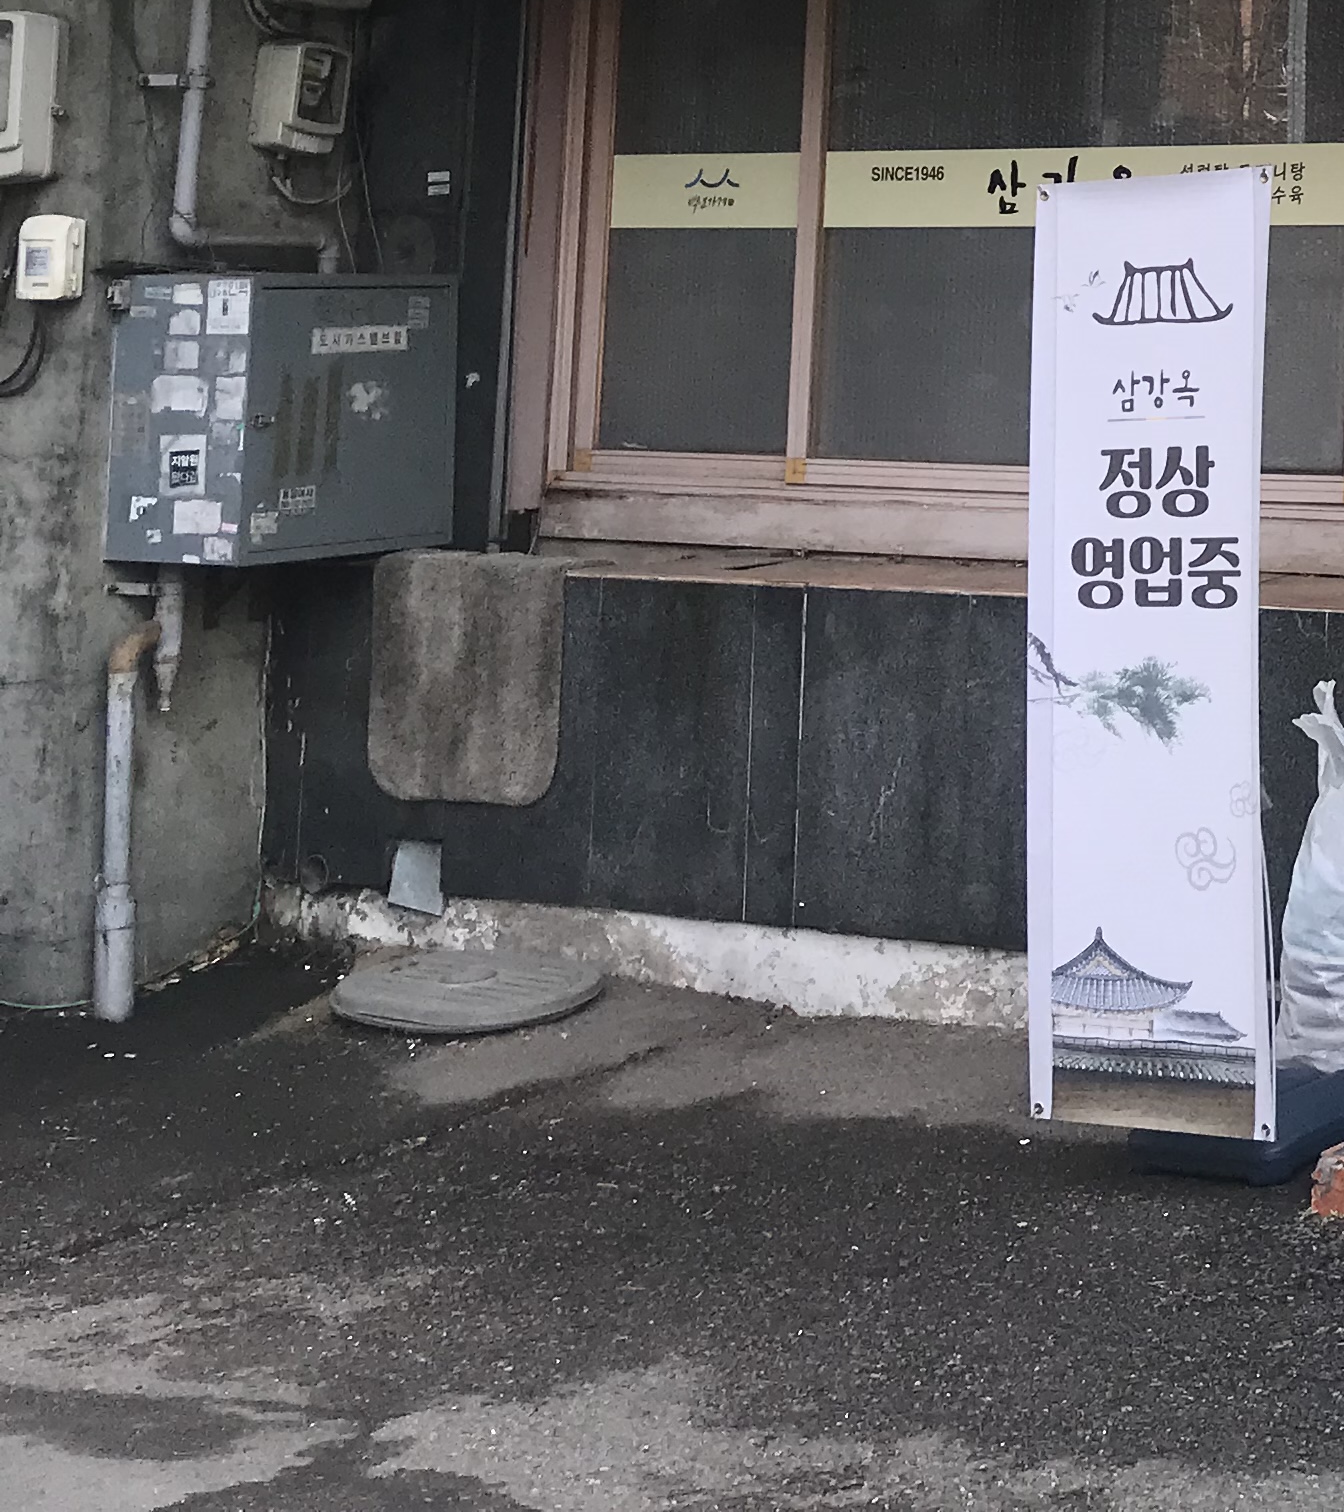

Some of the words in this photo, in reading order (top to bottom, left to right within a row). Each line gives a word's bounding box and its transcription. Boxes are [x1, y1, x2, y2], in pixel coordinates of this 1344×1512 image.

[871, 166, 945, 182] SINCE1946
[1112, 369, 1200, 412] 삼강옥
[1099, 445, 1215, 519] 정상
[1071, 536, 1242, 609] 영업중
